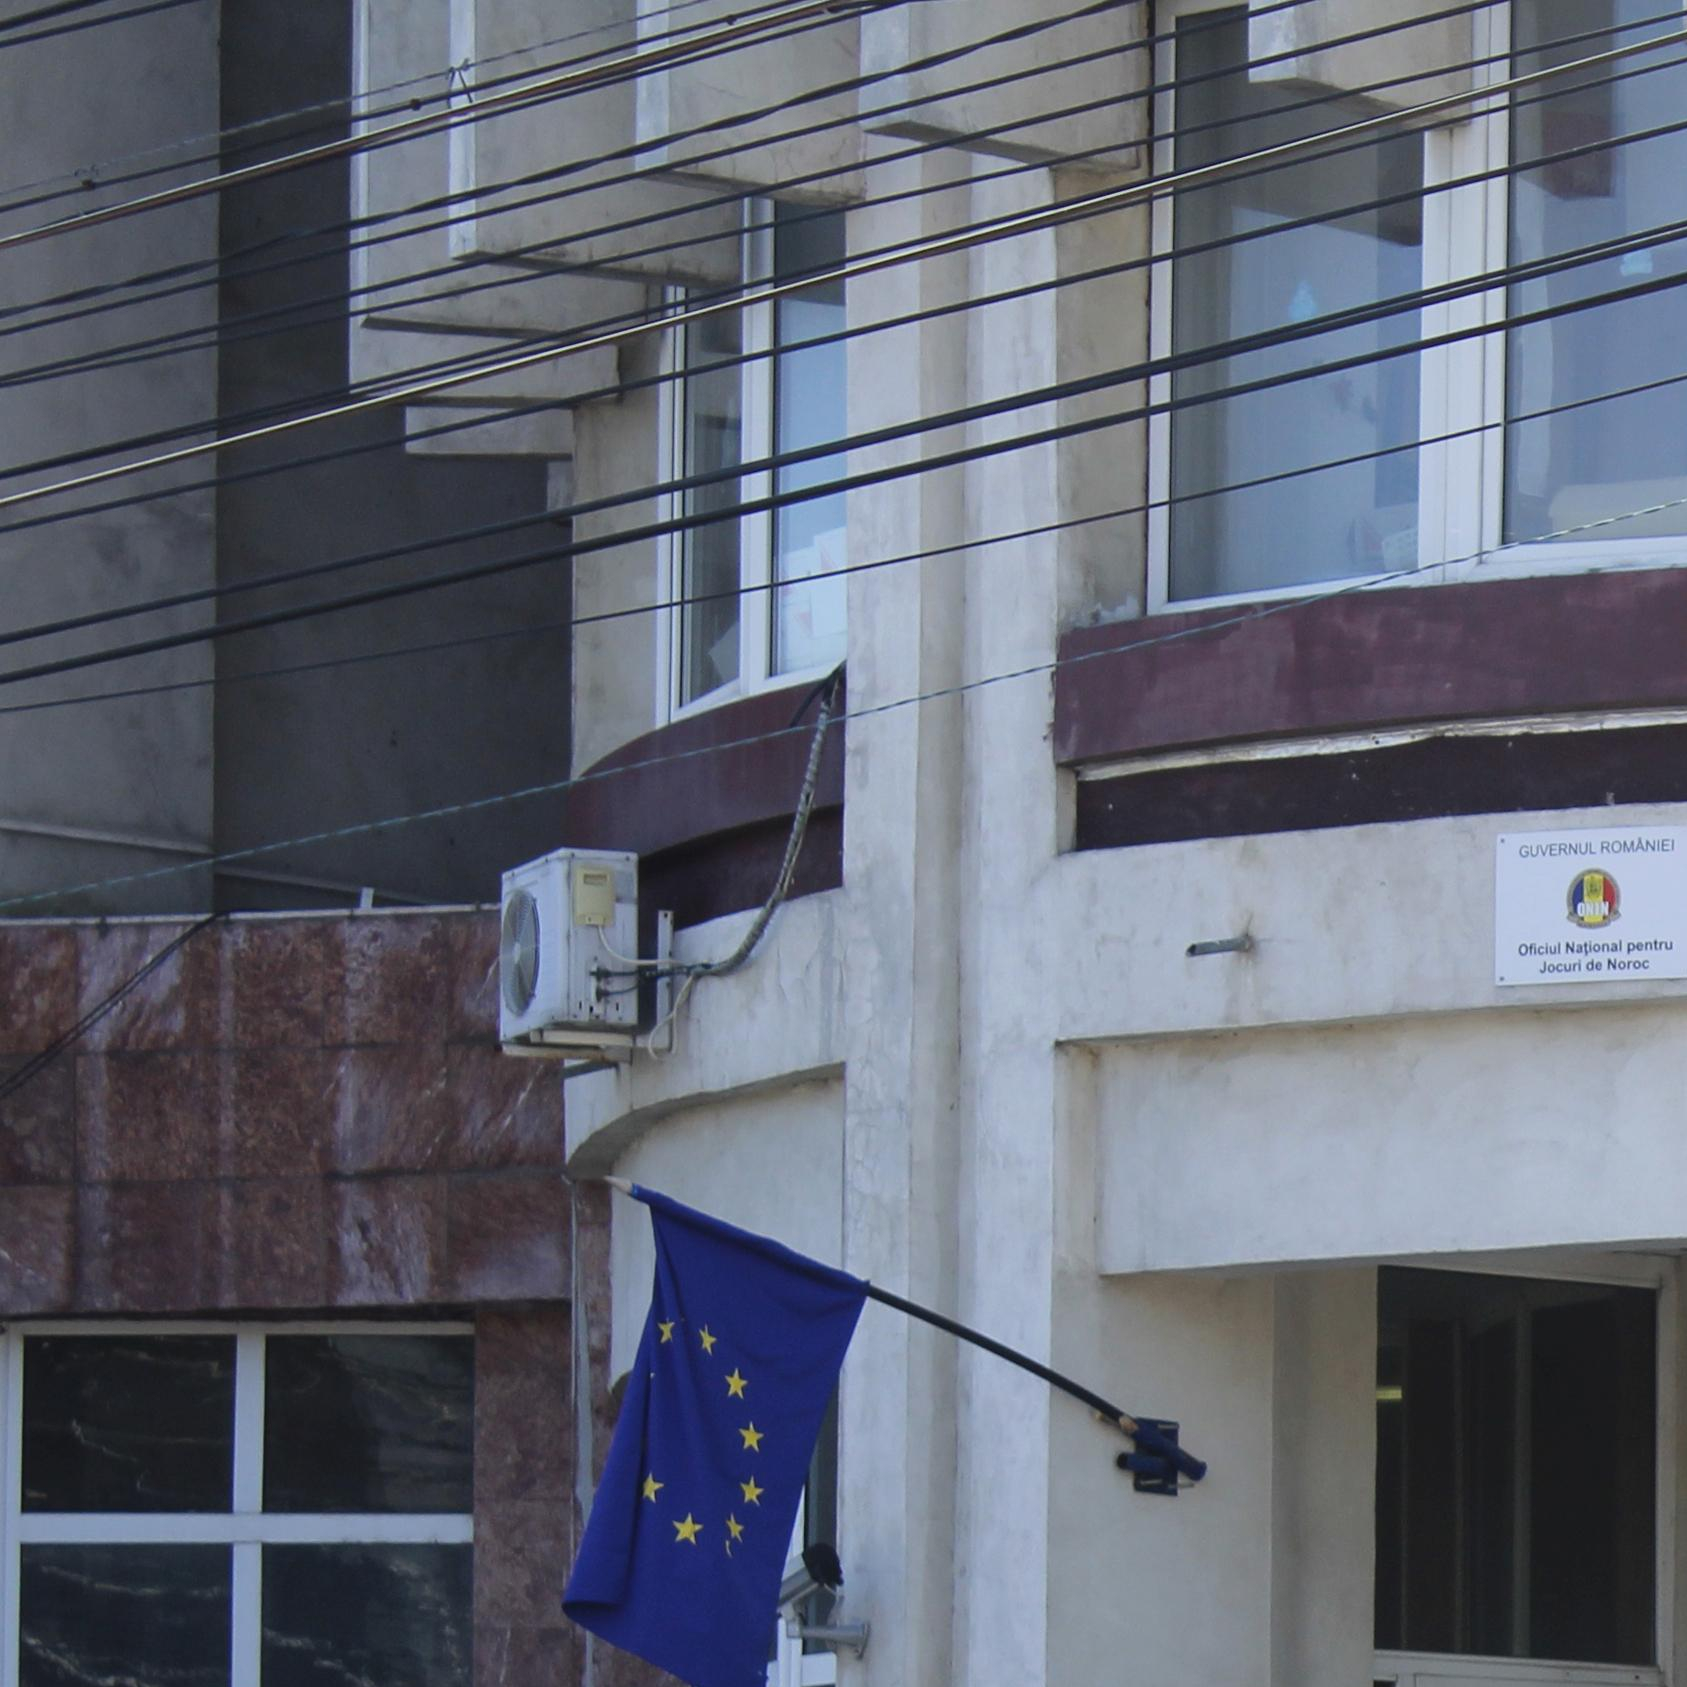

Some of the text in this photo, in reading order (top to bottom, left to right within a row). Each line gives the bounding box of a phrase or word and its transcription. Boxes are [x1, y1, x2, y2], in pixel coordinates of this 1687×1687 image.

[1518, 836, 1676, 859] GUVERNUL ROMÂNIEI
[1518, 941, 1562, 957] Oficiul
[1626, 939, 1674, 955] pentru
[1539, 957, 1650, 974] Jocuri de Noroc
